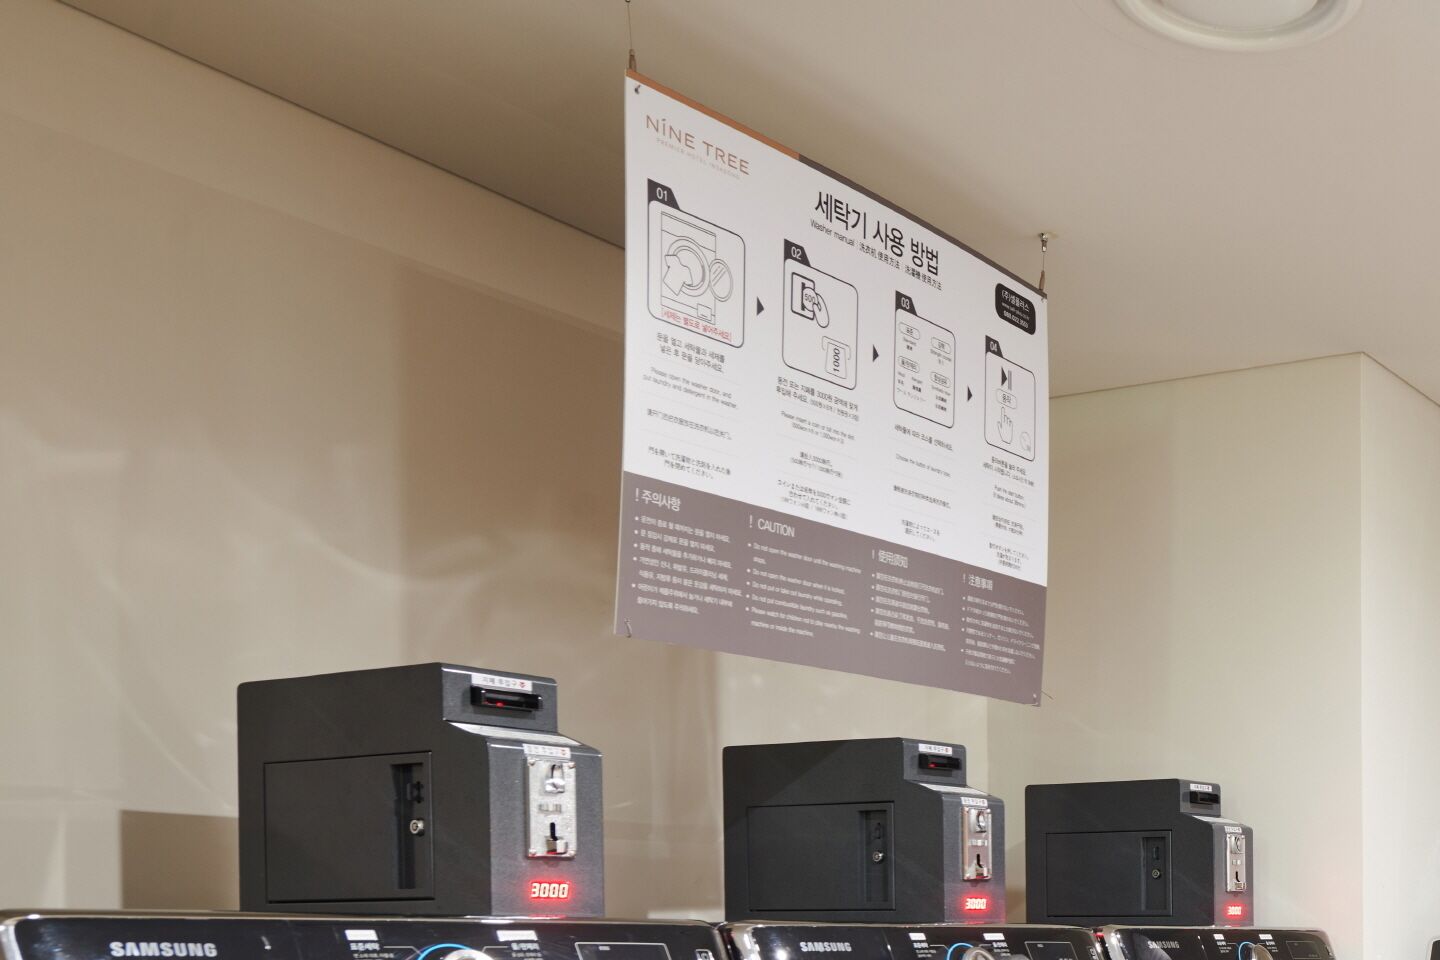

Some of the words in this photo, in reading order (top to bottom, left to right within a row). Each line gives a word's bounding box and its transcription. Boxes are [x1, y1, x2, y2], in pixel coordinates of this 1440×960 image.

[702, 140, 749, 175] TREE
[656, 187, 668, 201] 01
[810, 219, 832, 238] Washer
[834, 231, 854, 246] manual
[814, 191, 866, 239] 세탁기
[873, 221, 905, 257] 사용
[910, 238, 938, 275] 방법
[791, 246, 801, 260] 02
[901, 298, 910, 310] 03
[990, 342, 997, 352] 04
[833, 348, 841, 372] 1000
[641, 490, 681, 511] 주의사항
[758, 518, 796, 538] CAUTION
[530, 882, 569, 898] 3000
[965, 898, 987, 910] 3000
[109, 941, 218, 957] SAMSUNG
[800, 941, 852, 952] SAMSUNG
[1148, 940, 1180, 949] SAMSUNG
